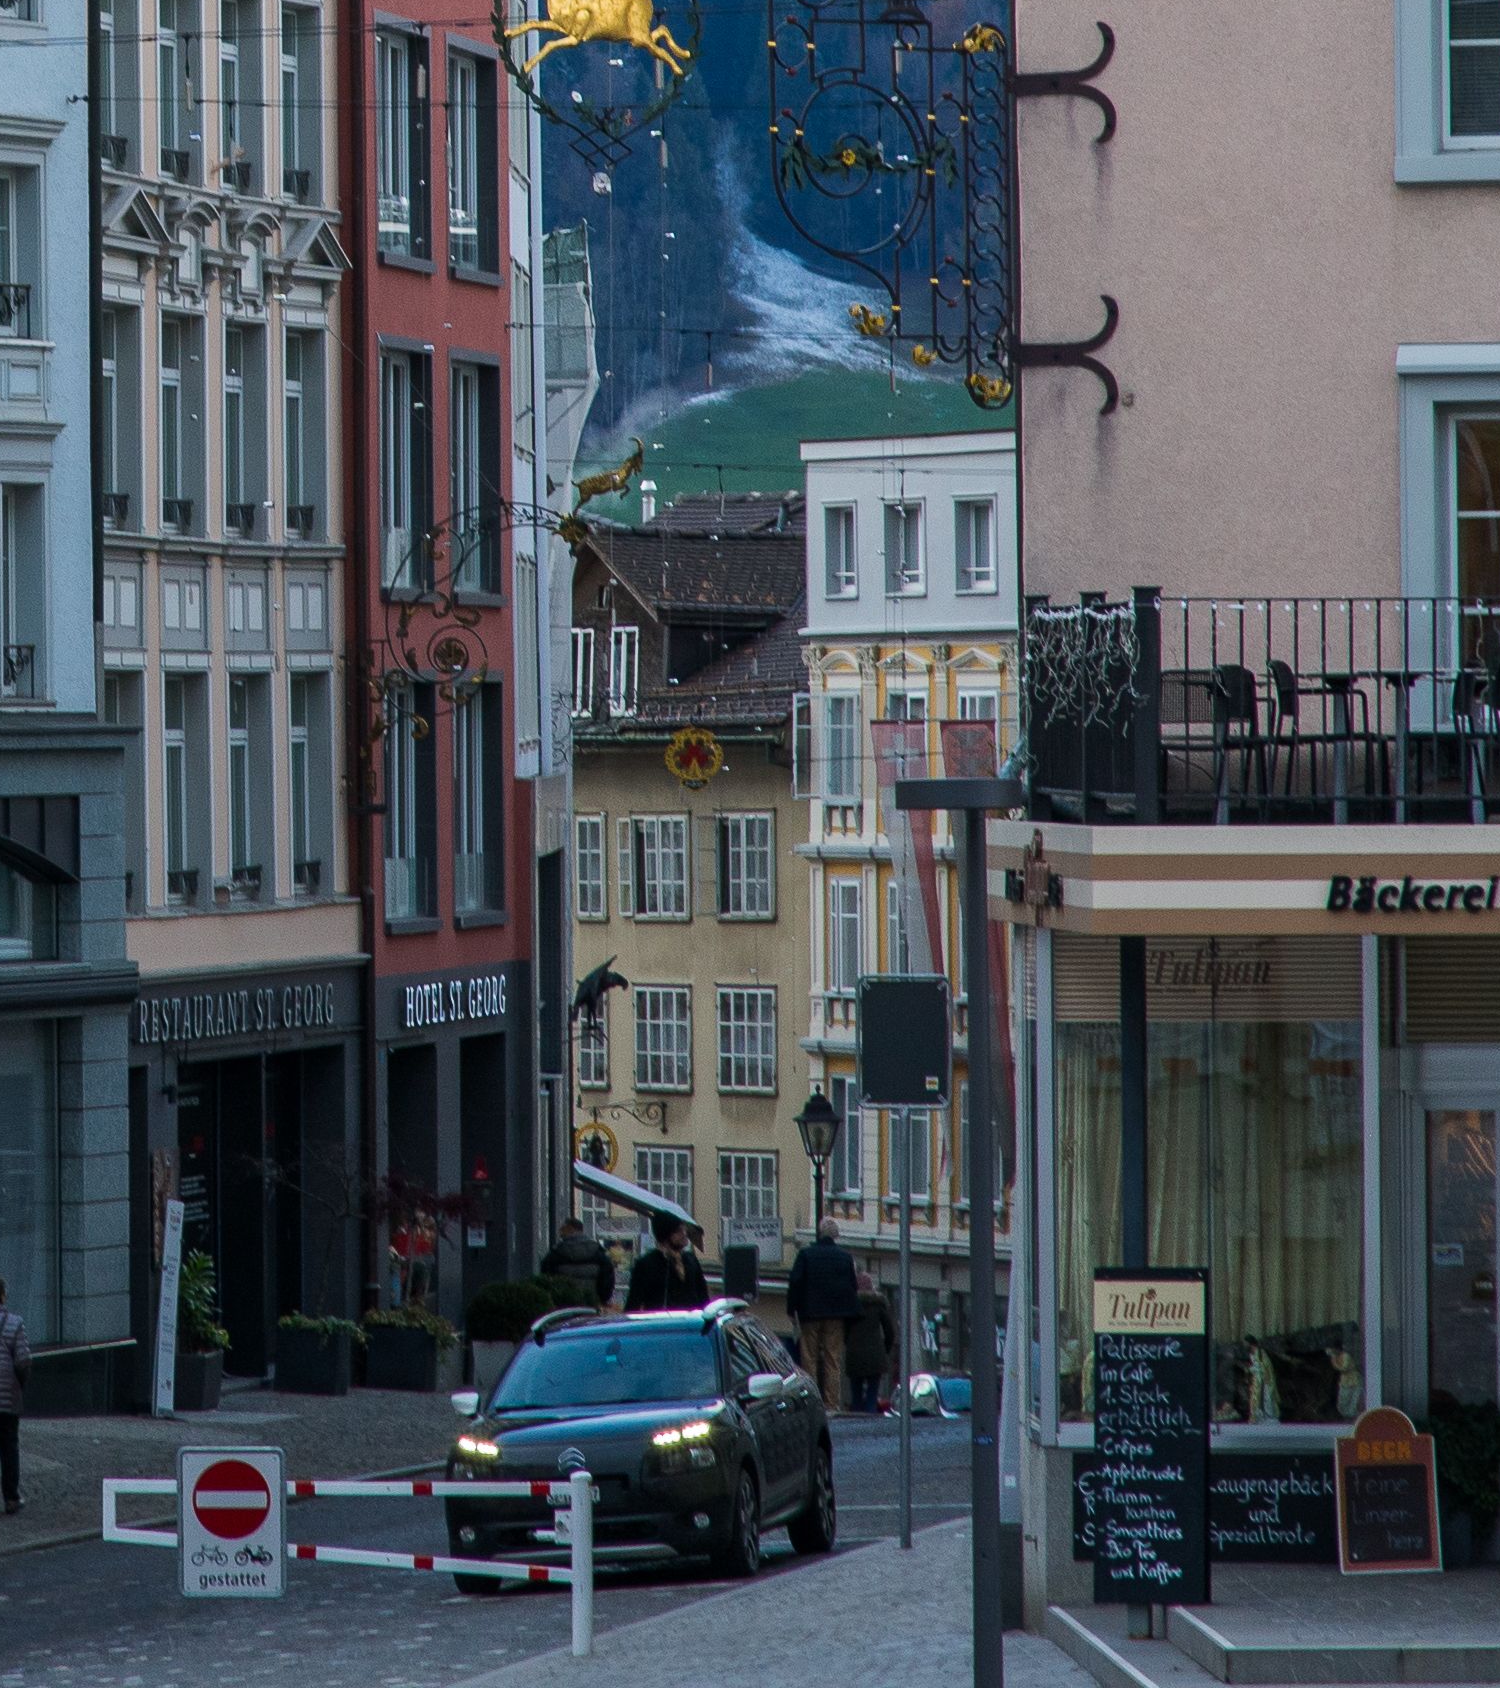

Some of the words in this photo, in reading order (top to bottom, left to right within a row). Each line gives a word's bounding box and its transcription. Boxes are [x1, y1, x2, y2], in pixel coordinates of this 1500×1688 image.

[1326, 874, 1499, 914] Bäckerei
[1149, 946, 1272, 999] Tulipan
[138, 989, 250, 1044] RESTAURANT
[256, 987, 279, 1032] ST.
[283, 983, 335, 1029] GEORG
[405, 981, 445, 1028] HOTEL
[449, 979, 466, 1023] ST.
[468, 974, 507, 1019] GEORG
[1109, 1288, 1191, 1328] Tulipan
[1119, 1384, 1170, 1405] Stock
[1099, 1403, 1193, 1429] erhältlich
[1210, 1471, 1335, 1504] augengebäck
[1248, 1503, 1281, 1524] und
[1106, 1519, 1183, 1542] Smoothies
[198, 1569, 267, 1590] gestattet
